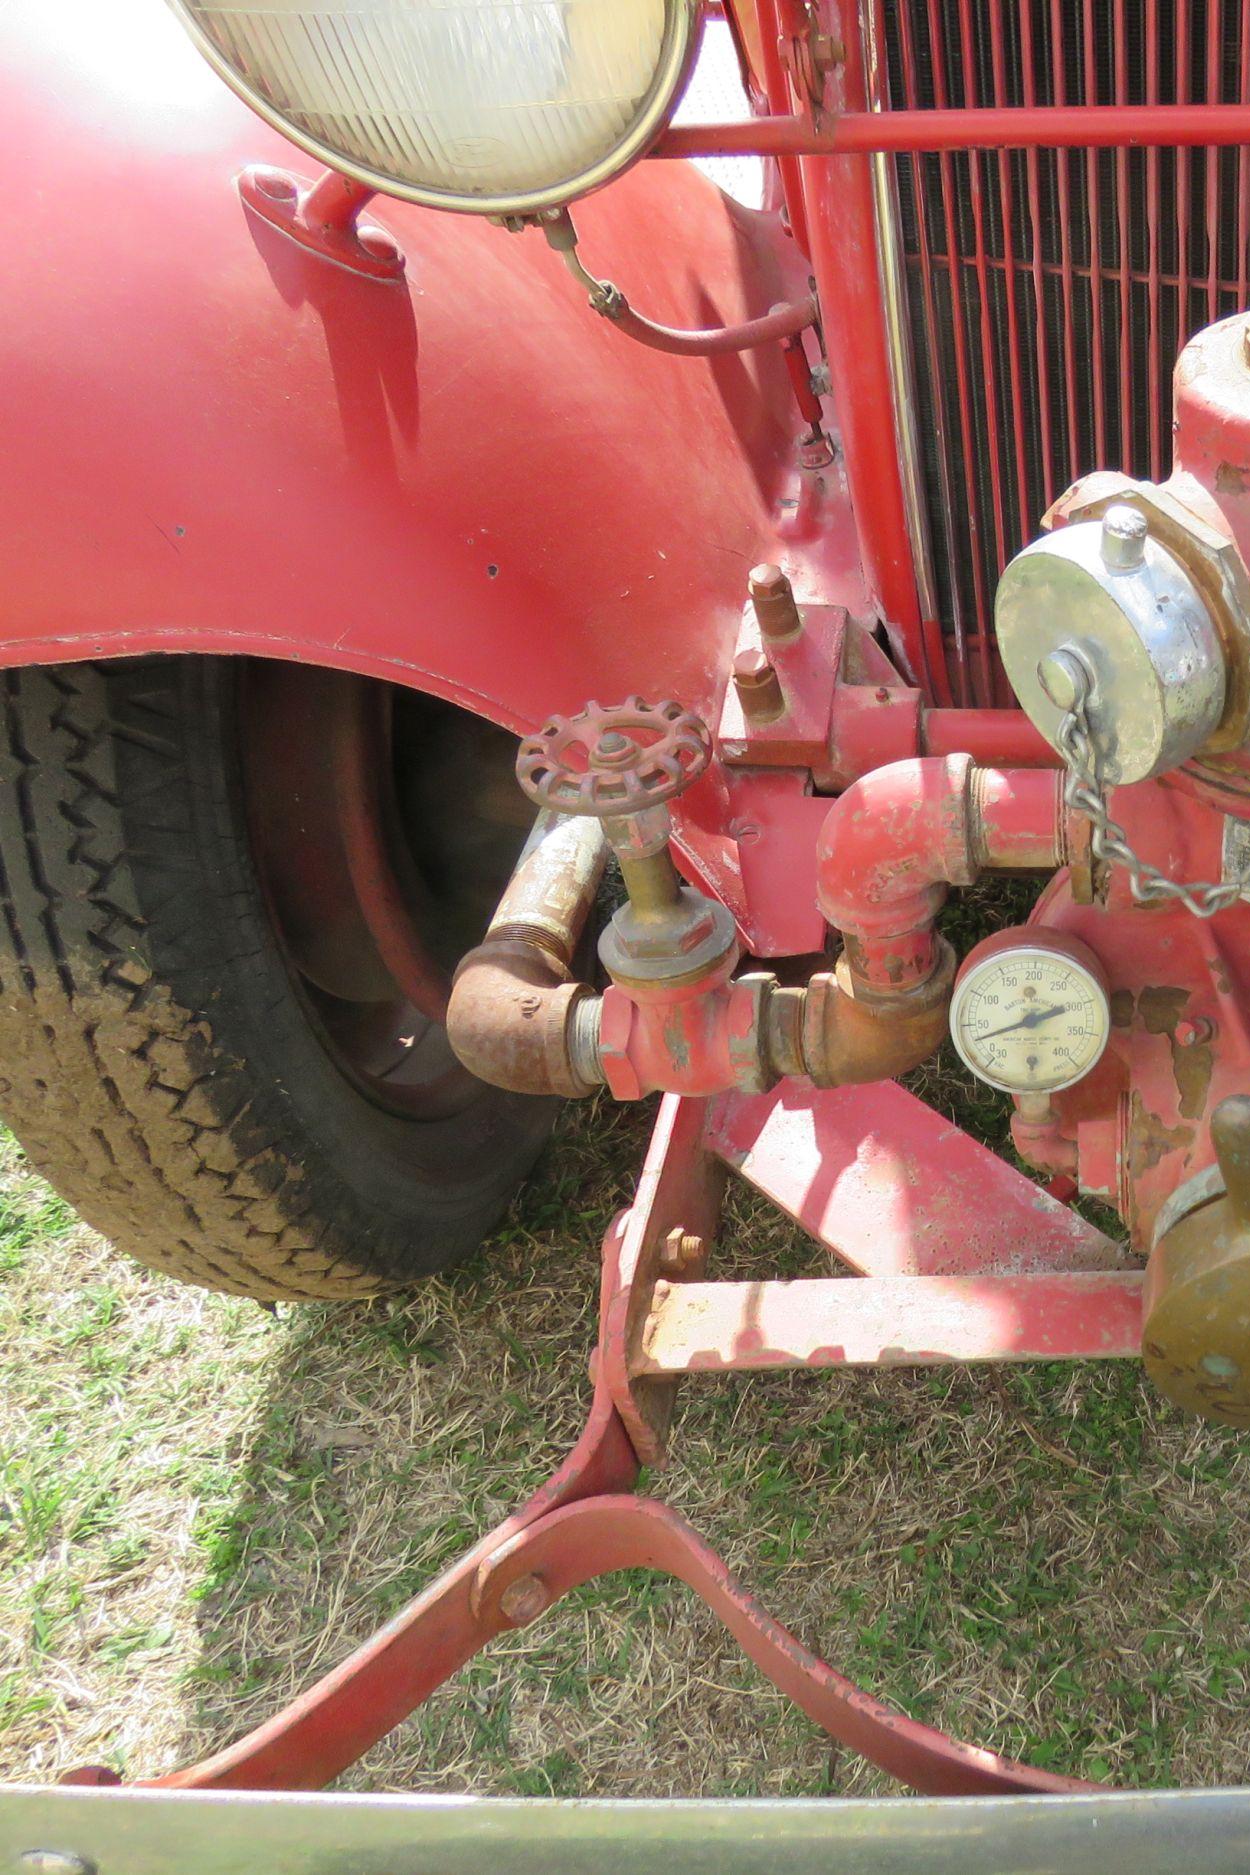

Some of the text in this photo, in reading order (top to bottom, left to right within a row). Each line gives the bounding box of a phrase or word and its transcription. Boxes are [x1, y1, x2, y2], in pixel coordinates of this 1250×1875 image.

[1025, 971, 1042, 981] 200
[1001, 977, 1018, 987] 150
[1050, 981, 1067, 991] 250
[983, 995, 999, 1005] 100
[1065, 1002, 1082, 1011] 300
[977, 1020, 989, 1029] 50
[1067, 1027, 1084, 1036] 350
[989, 1043, 995, 1053] 0
[996, 1048, 1007, 1058] 30
[1052, 1047, 1069, 1057] 400
